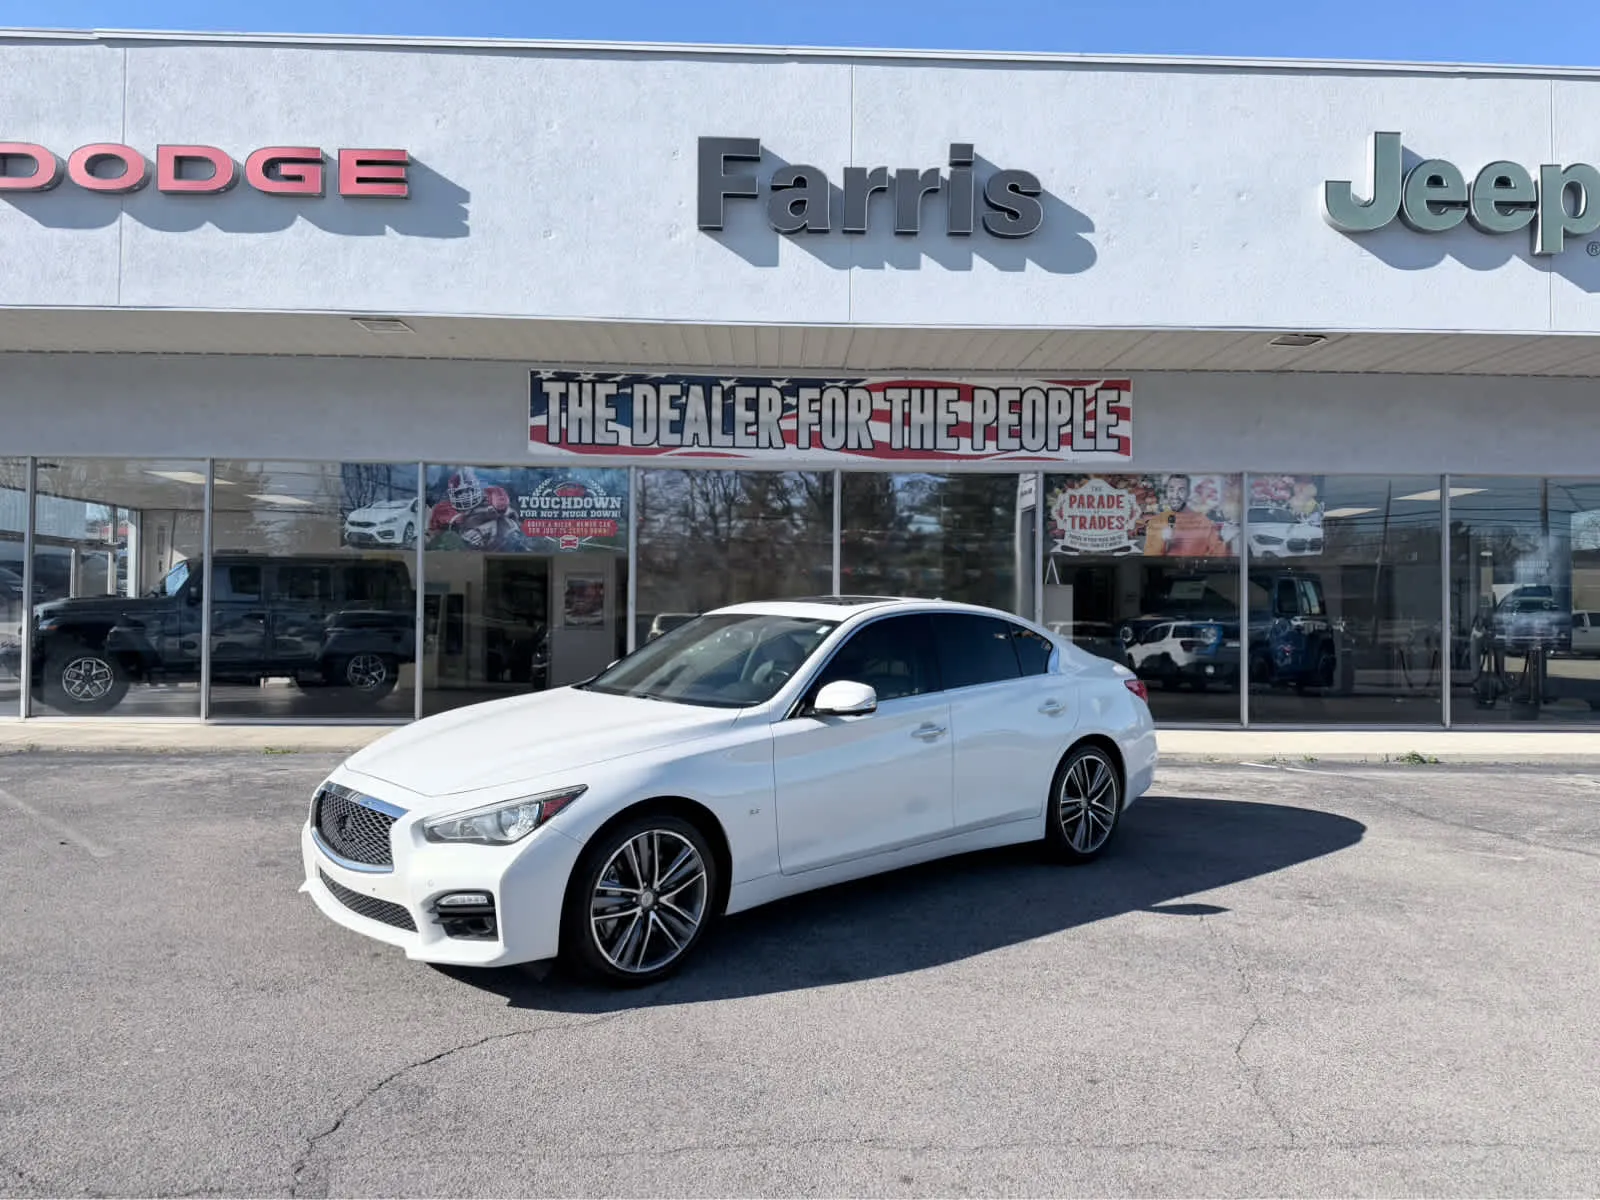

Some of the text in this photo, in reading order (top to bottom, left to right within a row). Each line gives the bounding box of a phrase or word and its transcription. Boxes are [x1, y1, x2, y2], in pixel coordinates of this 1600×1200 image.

[0, 141, 409, 198] DODGE
[698, 136, 1043, 238] Farris
[1321, 131, 1600, 255] Jeep
[542, 380, 1121, 452] THE DEALER FOR THE PEOPLE
[518, 495, 622, 509] TOUCHDOWN
[520, 510, 537, 518] FOR
[540, 510, 559, 518] NOT
[562, 510, 587, 518] MUCH
[1069, 494, 1126, 509] PARADE
[1067, 515, 1126, 530] TRADES
